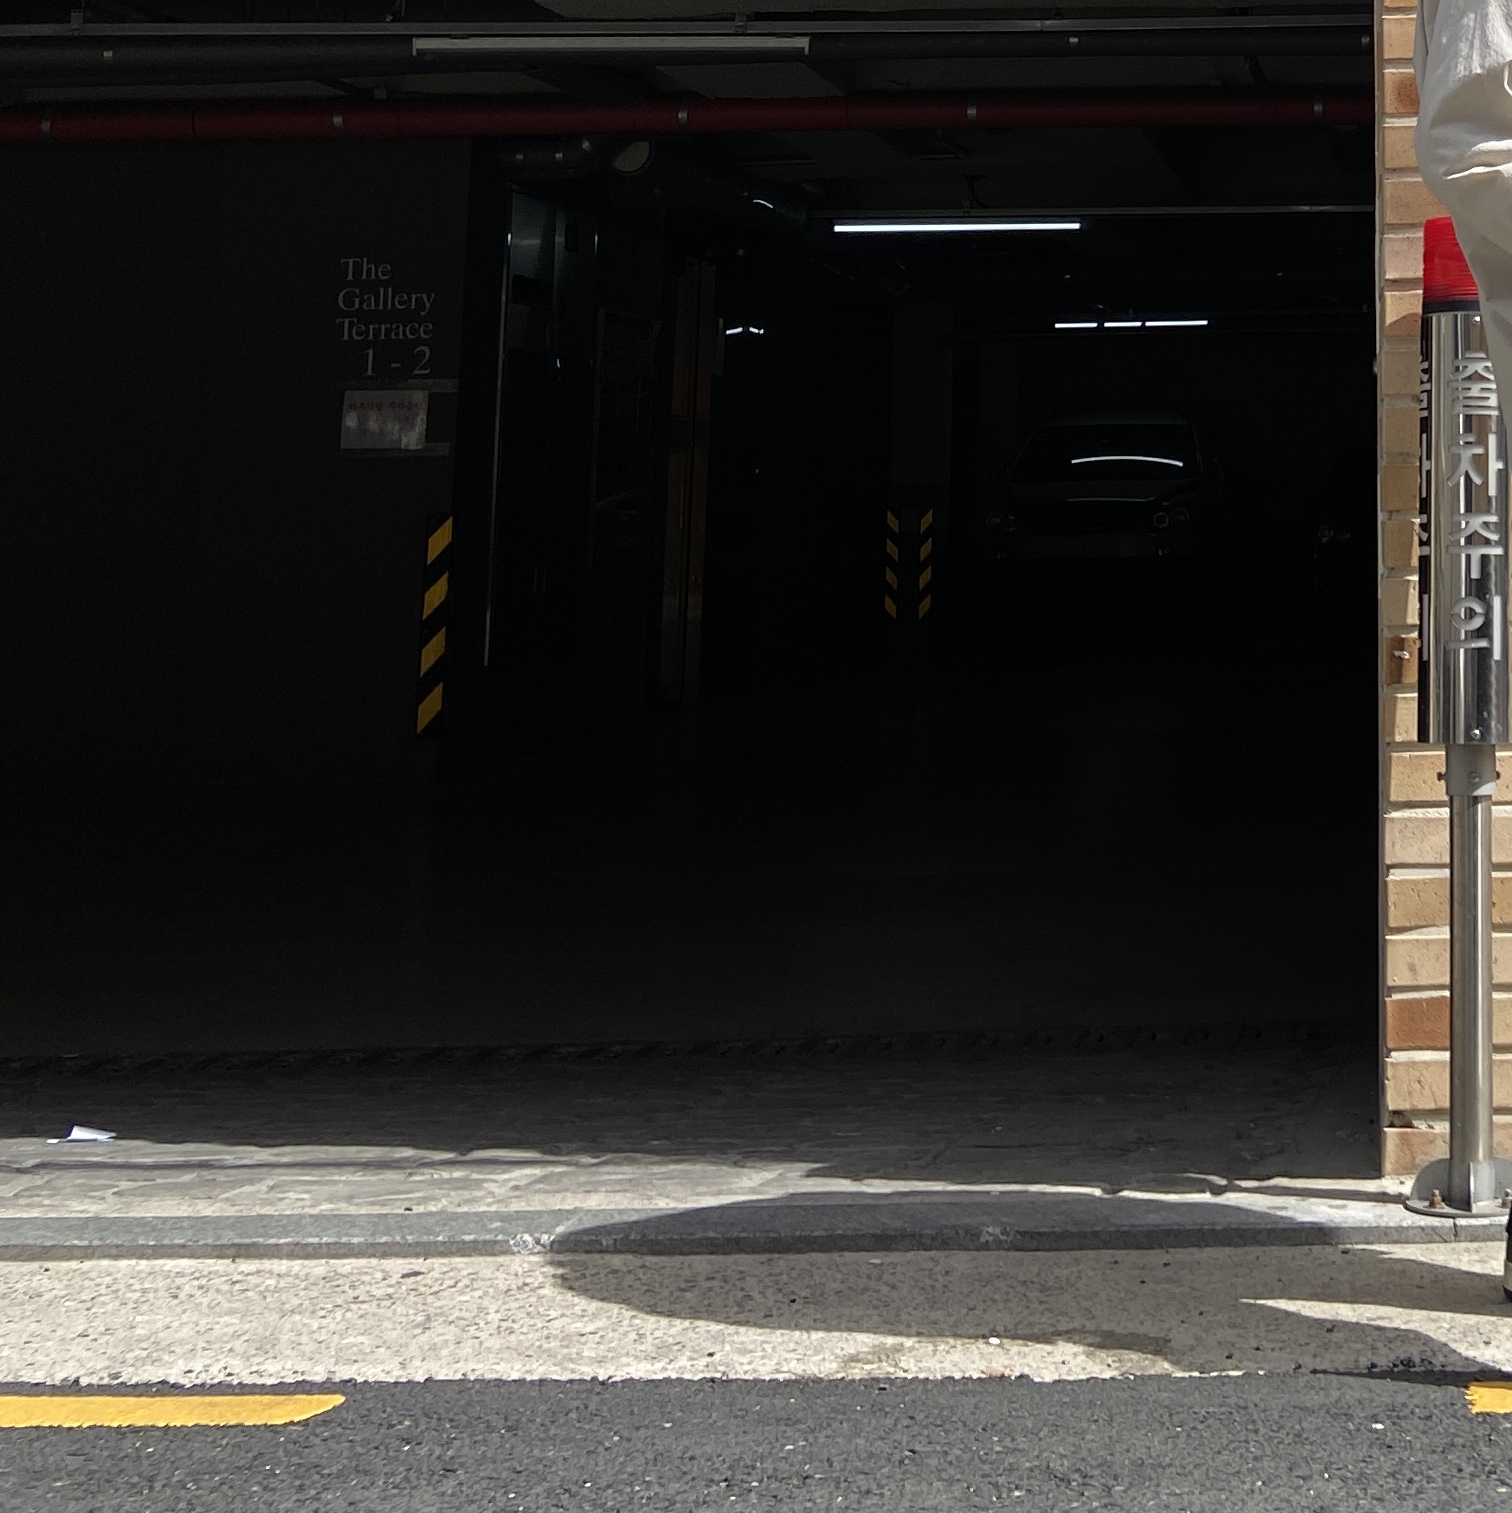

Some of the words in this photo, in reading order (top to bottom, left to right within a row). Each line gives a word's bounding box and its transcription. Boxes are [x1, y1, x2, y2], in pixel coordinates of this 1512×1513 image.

[340, 257, 392, 281] The
[338, 287, 434, 316] Gallery
[335, 318, 433, 340] Terrace
[1446, 350, 1504, 661] 출차주의
